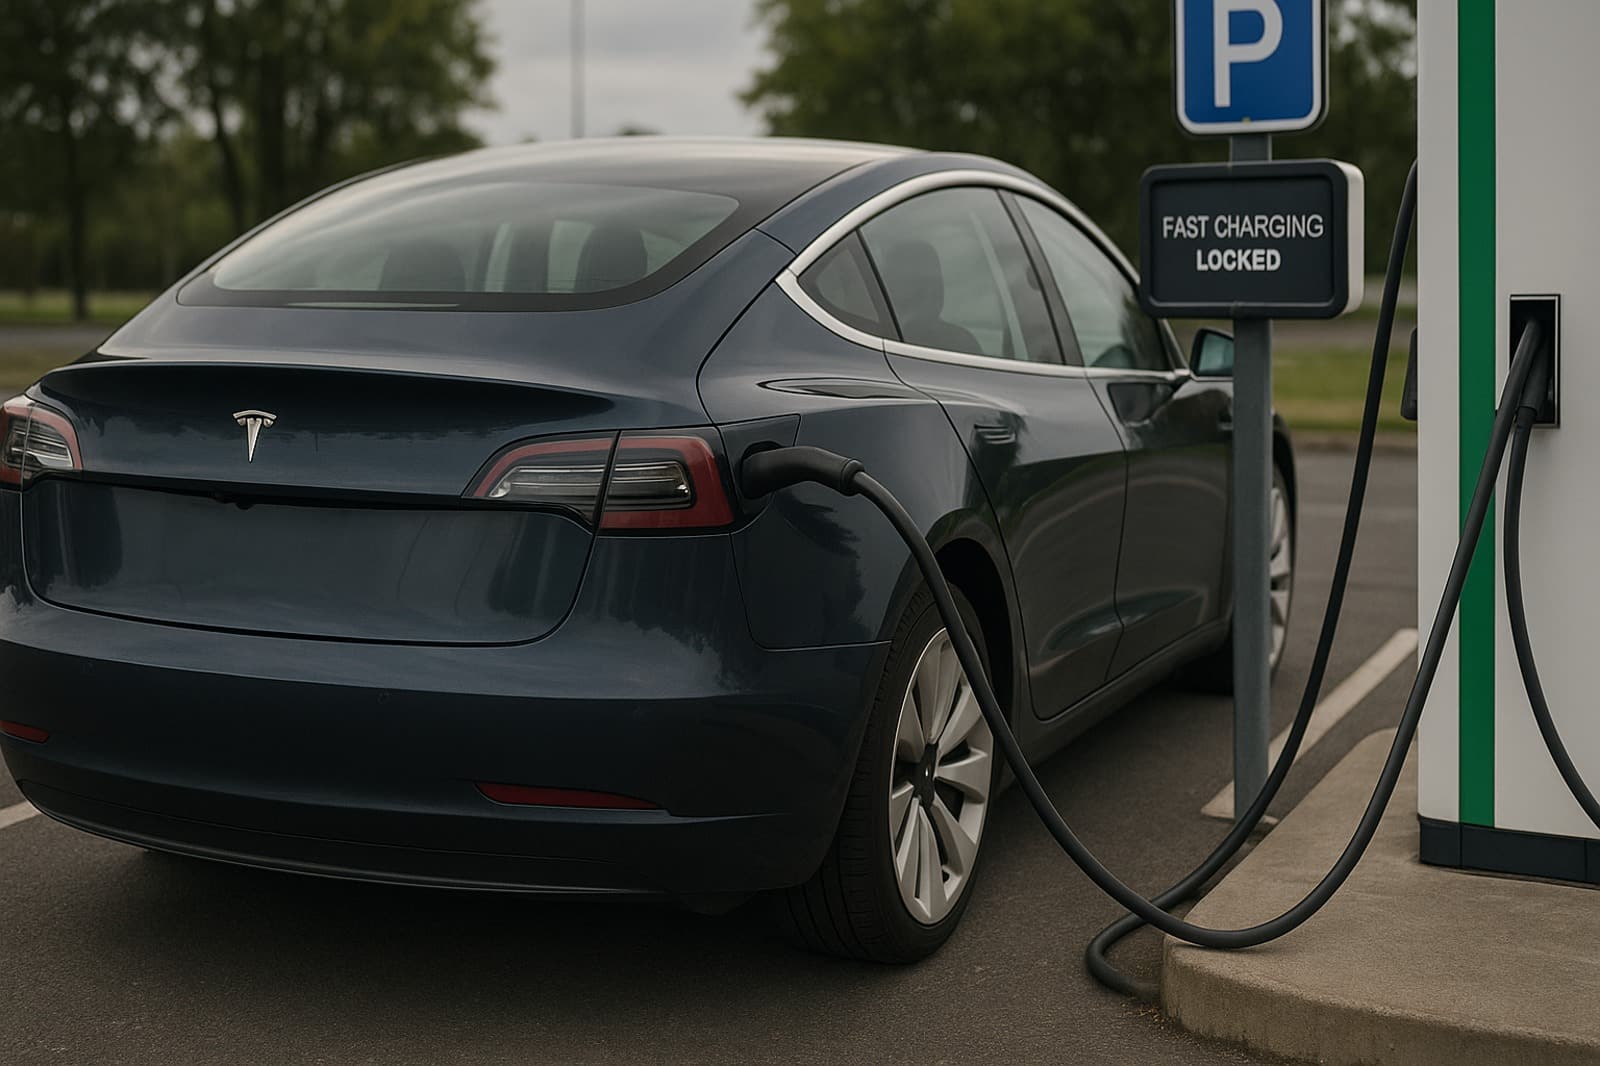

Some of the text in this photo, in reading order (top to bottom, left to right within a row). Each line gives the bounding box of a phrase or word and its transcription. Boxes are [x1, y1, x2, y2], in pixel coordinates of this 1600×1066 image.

[1213, 0, 1283, 107] P
[1163, 214, 1324, 238] FAST CHARGING
[1197, 249, 1281, 271] LOCKED
